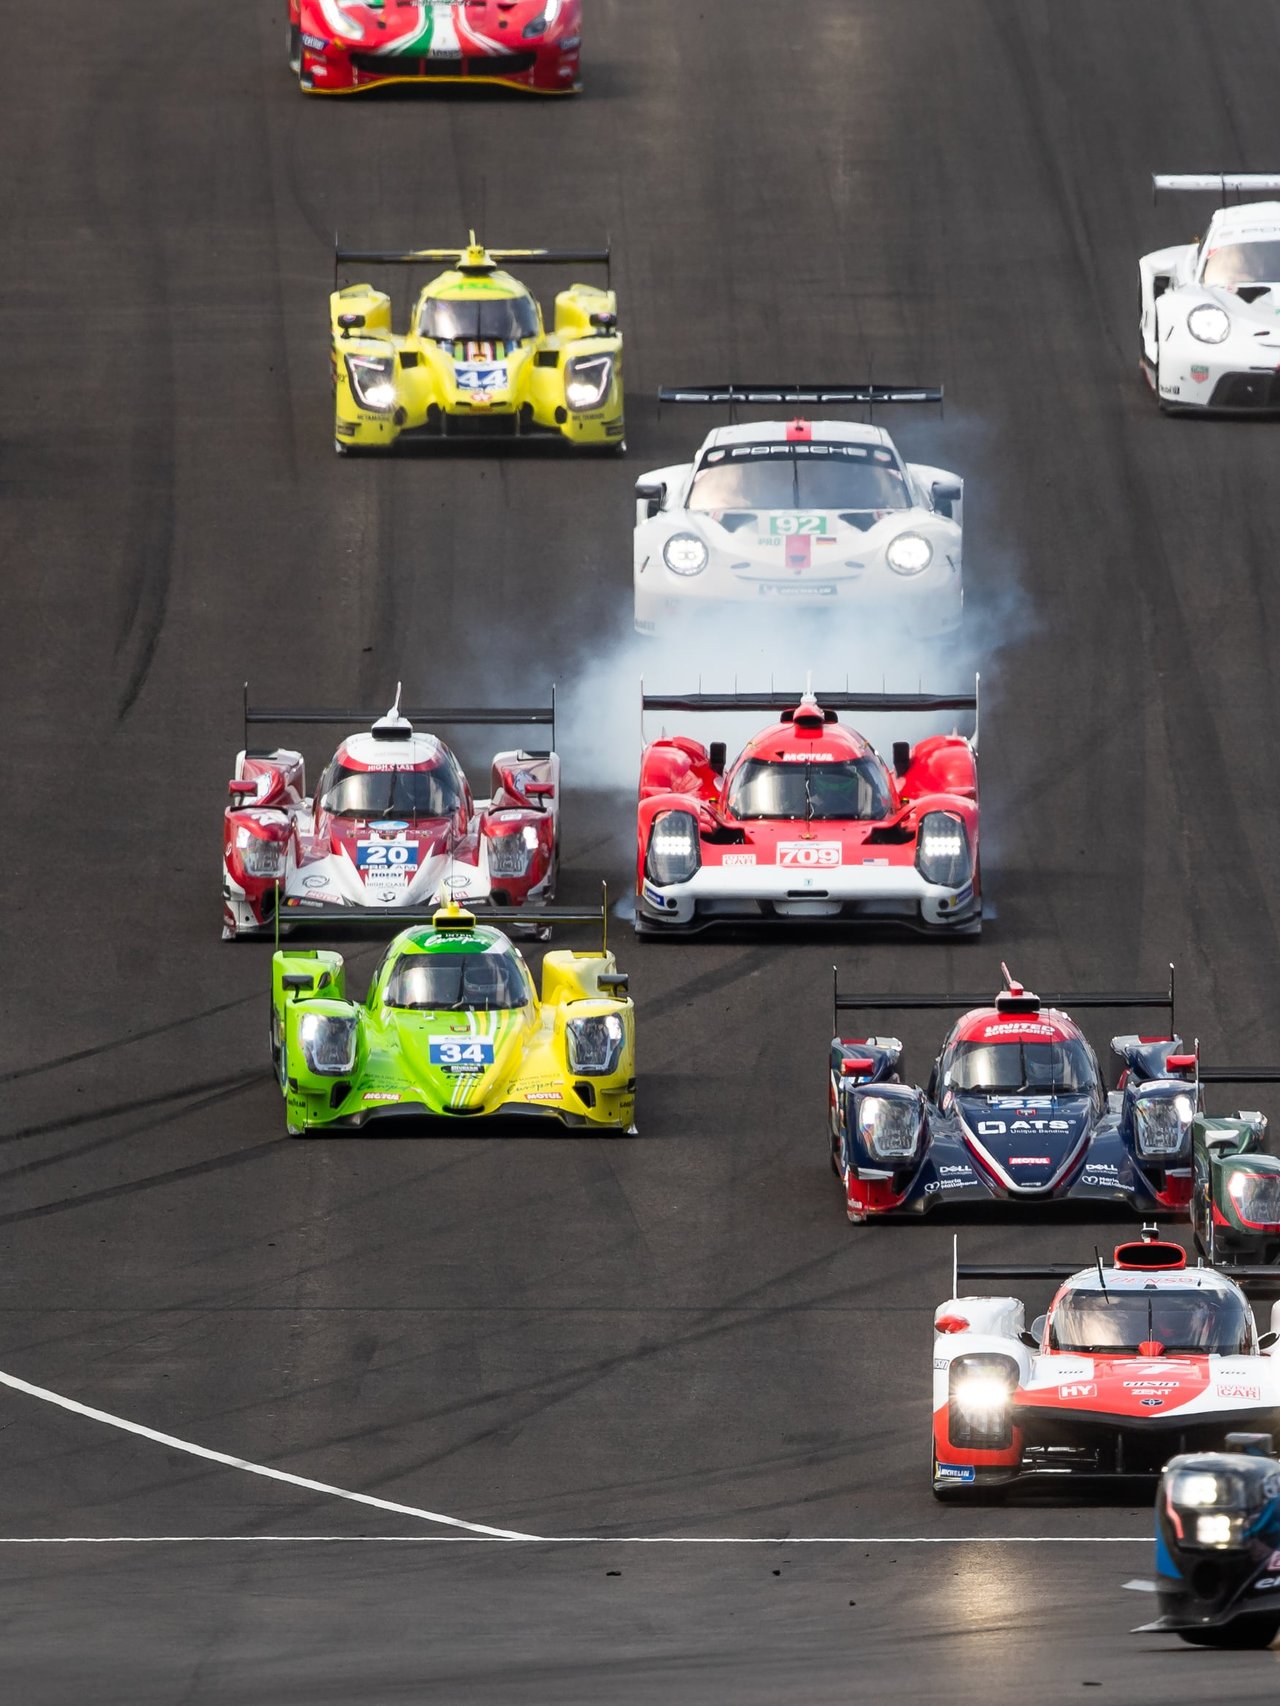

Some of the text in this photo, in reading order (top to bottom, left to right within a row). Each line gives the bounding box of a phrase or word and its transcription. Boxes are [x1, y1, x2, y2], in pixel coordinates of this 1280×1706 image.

[457, 370, 507, 389] 44
[776, 516, 821, 535] 92
[783, 753, 834, 761] MOTUL
[366, 847, 408, 864] 20
[780, 850, 839, 865] 709
[985, 1023, 1055, 1033] UNITED
[440, 1043, 484, 1063] 34
[999, 1100, 1052, 1109] 22
[1010, 1120, 1070, 1130] ATS
[1011, 1157, 1051, 1165] MOTUL
[940, 1165, 972, 1173] DELL
[1061, 1386, 1092, 1397] HY
[1220, 1389, 1258, 1399] CAR
